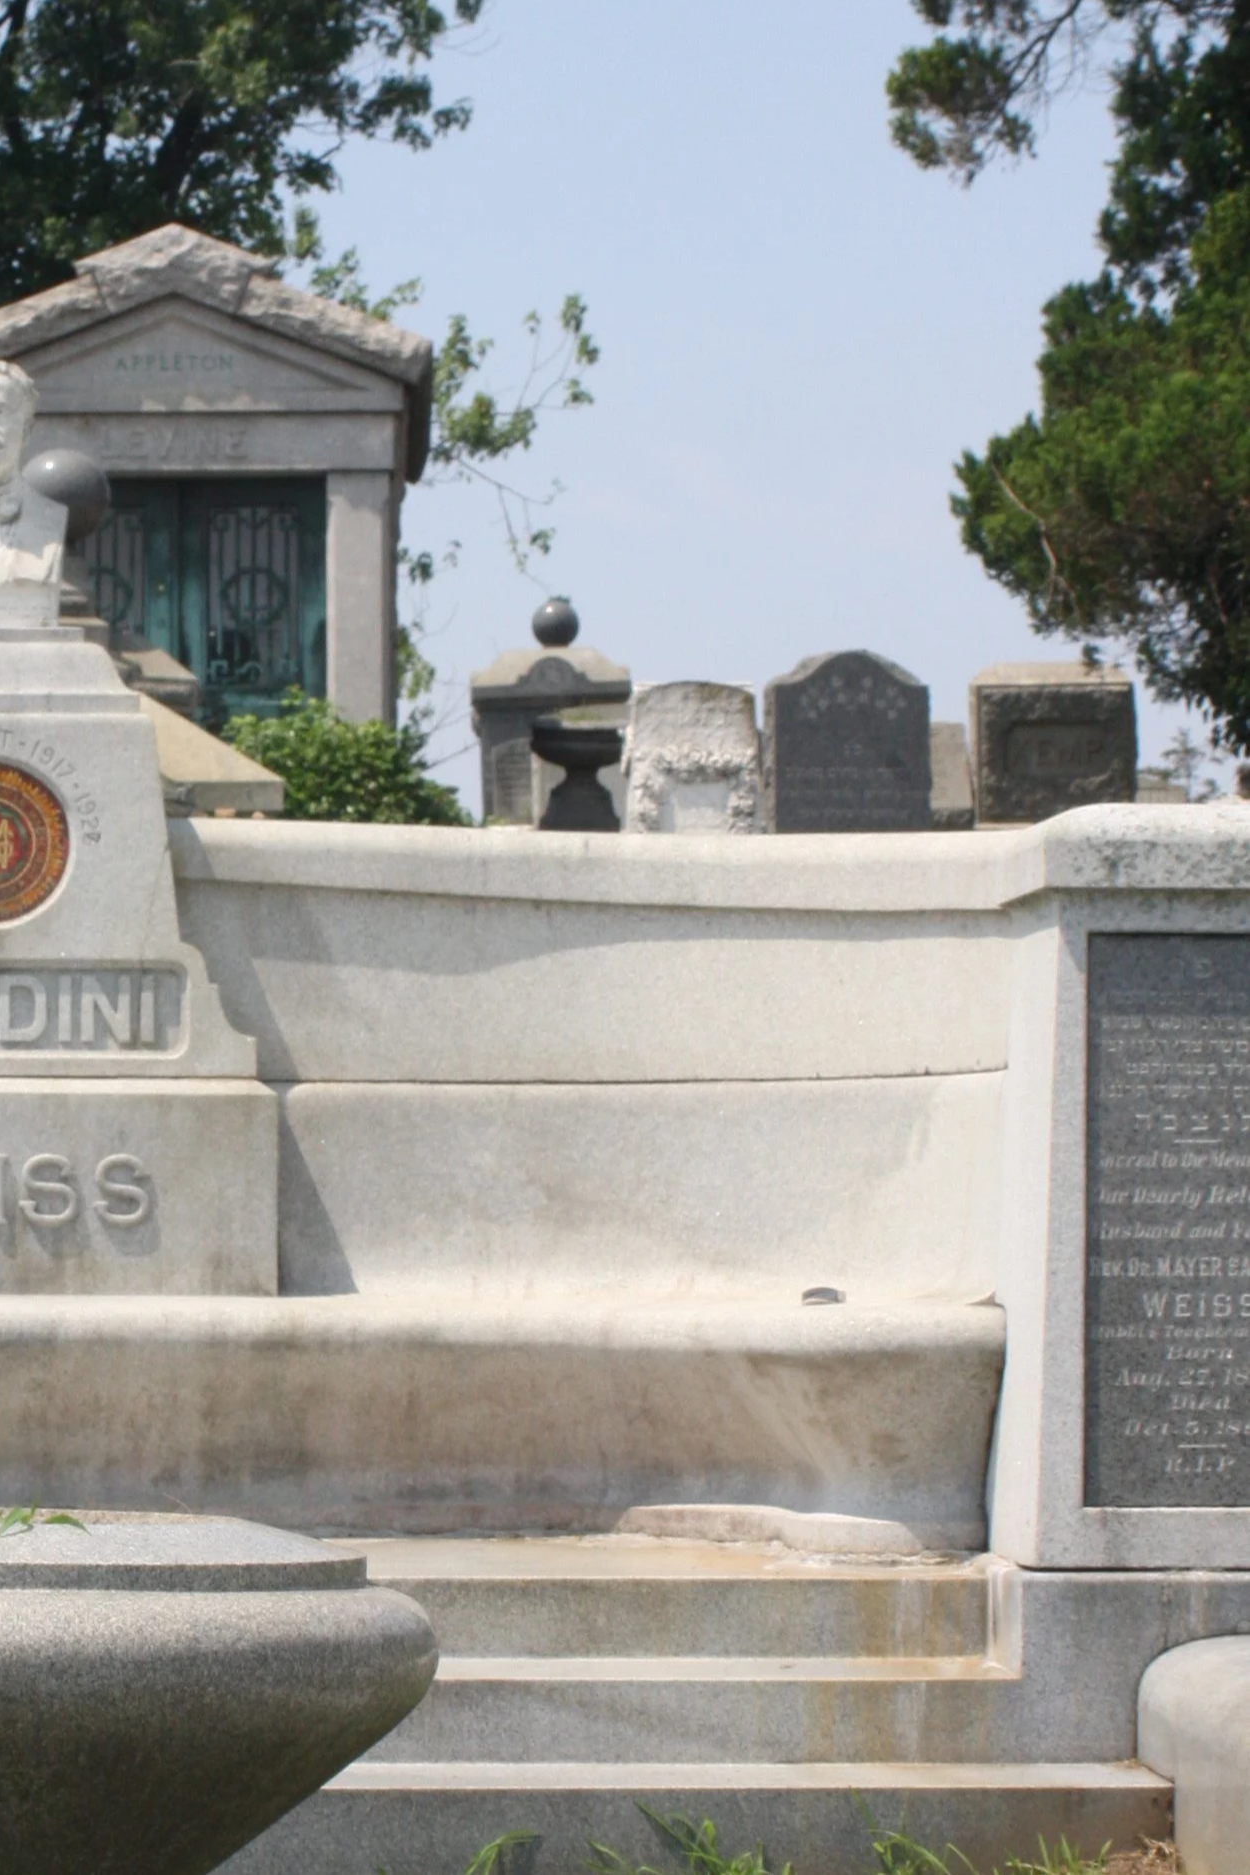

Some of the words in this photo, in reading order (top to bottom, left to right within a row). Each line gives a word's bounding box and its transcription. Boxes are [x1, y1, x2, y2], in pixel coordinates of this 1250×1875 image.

[113, 354, 235, 372] APPLETON
[30, 740, 77, 778] 1917
[1131, 1186, 1203, 1210] Dearly
[1188, 1221, 1228, 1238] and
[1157, 1254, 1223, 1277] MAYER
